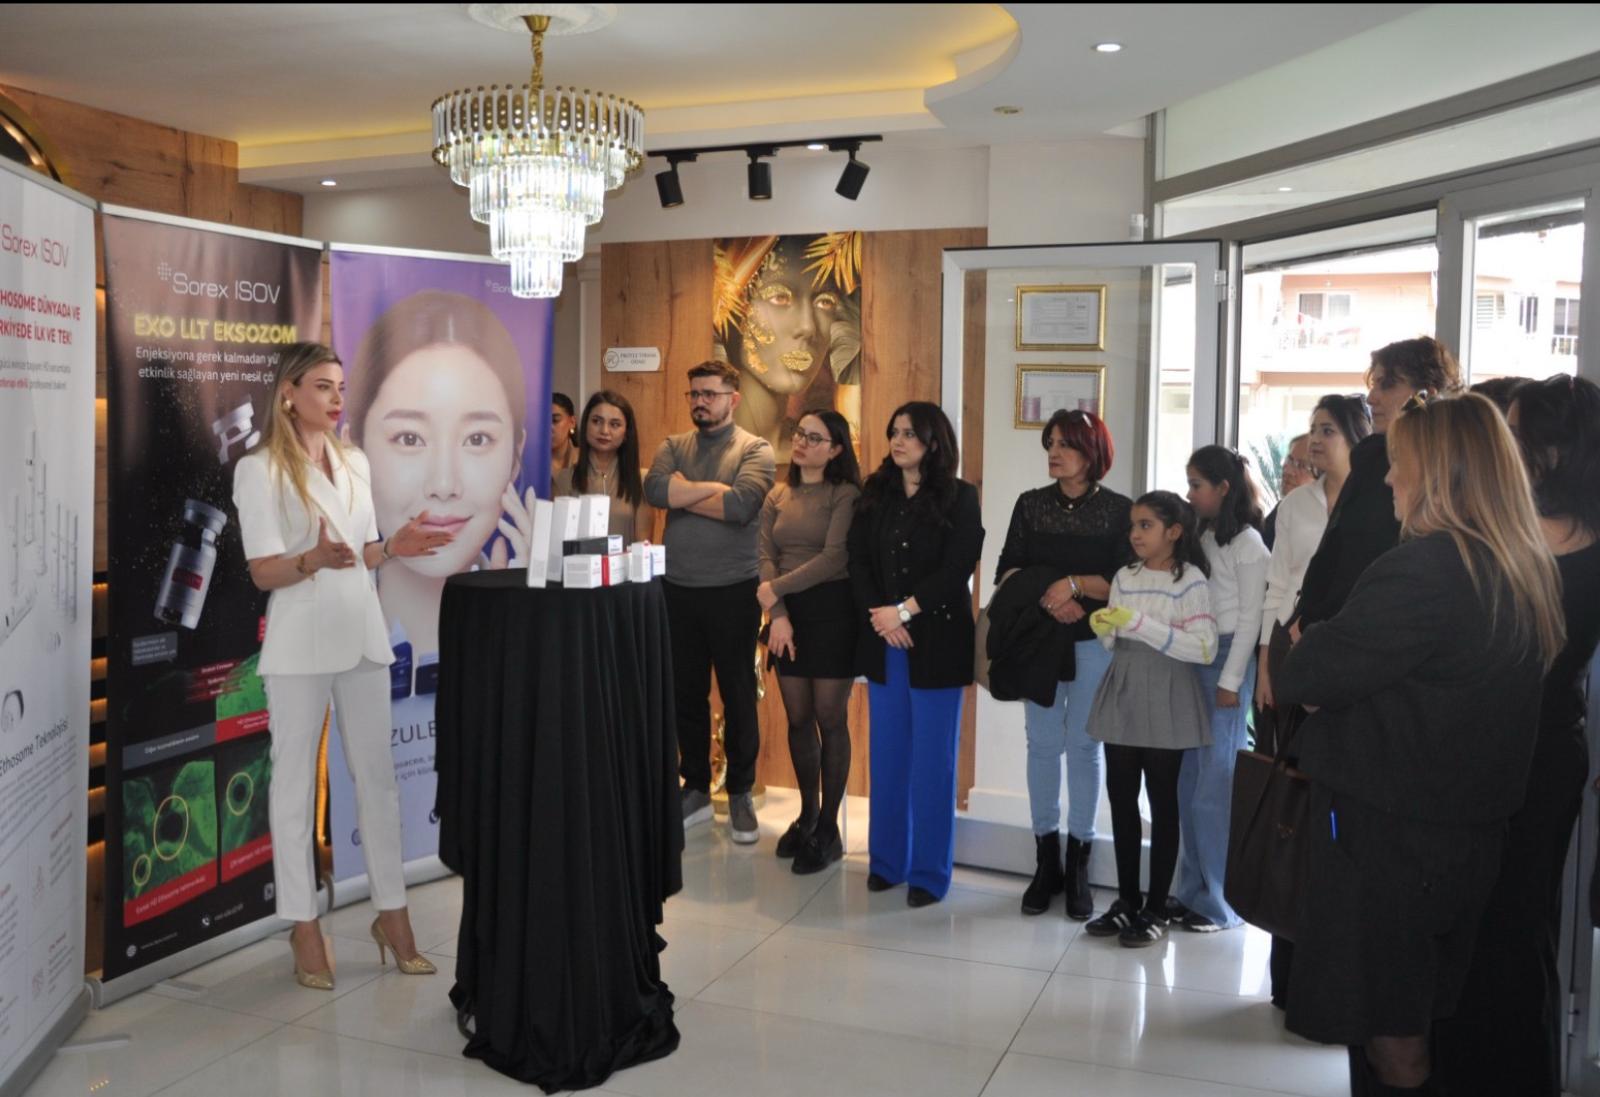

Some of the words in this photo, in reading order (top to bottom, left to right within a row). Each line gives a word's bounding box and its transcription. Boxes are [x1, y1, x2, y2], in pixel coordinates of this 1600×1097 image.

[2, 224, 37, 257] Sorex
[41, 237, 69, 268] ISOV
[172, 272, 229, 298] Sorex
[235, 280, 281, 304] ISOV
[134, 314, 175, 337] EXO
[181, 318, 209, 340] LLT
[214, 322, 297, 344] EKSOZOM
[135, 347, 194, 362] Enjeksiyona
[196, 349, 222, 364] gerek
[224, 350, 265, 365] kalmadan
[138, 368, 175, 379] etkinlik
[176, 368, 219, 382] sağlayan
[220, 370, 239, 384] yeni
[241, 371, 261, 382] nesil
